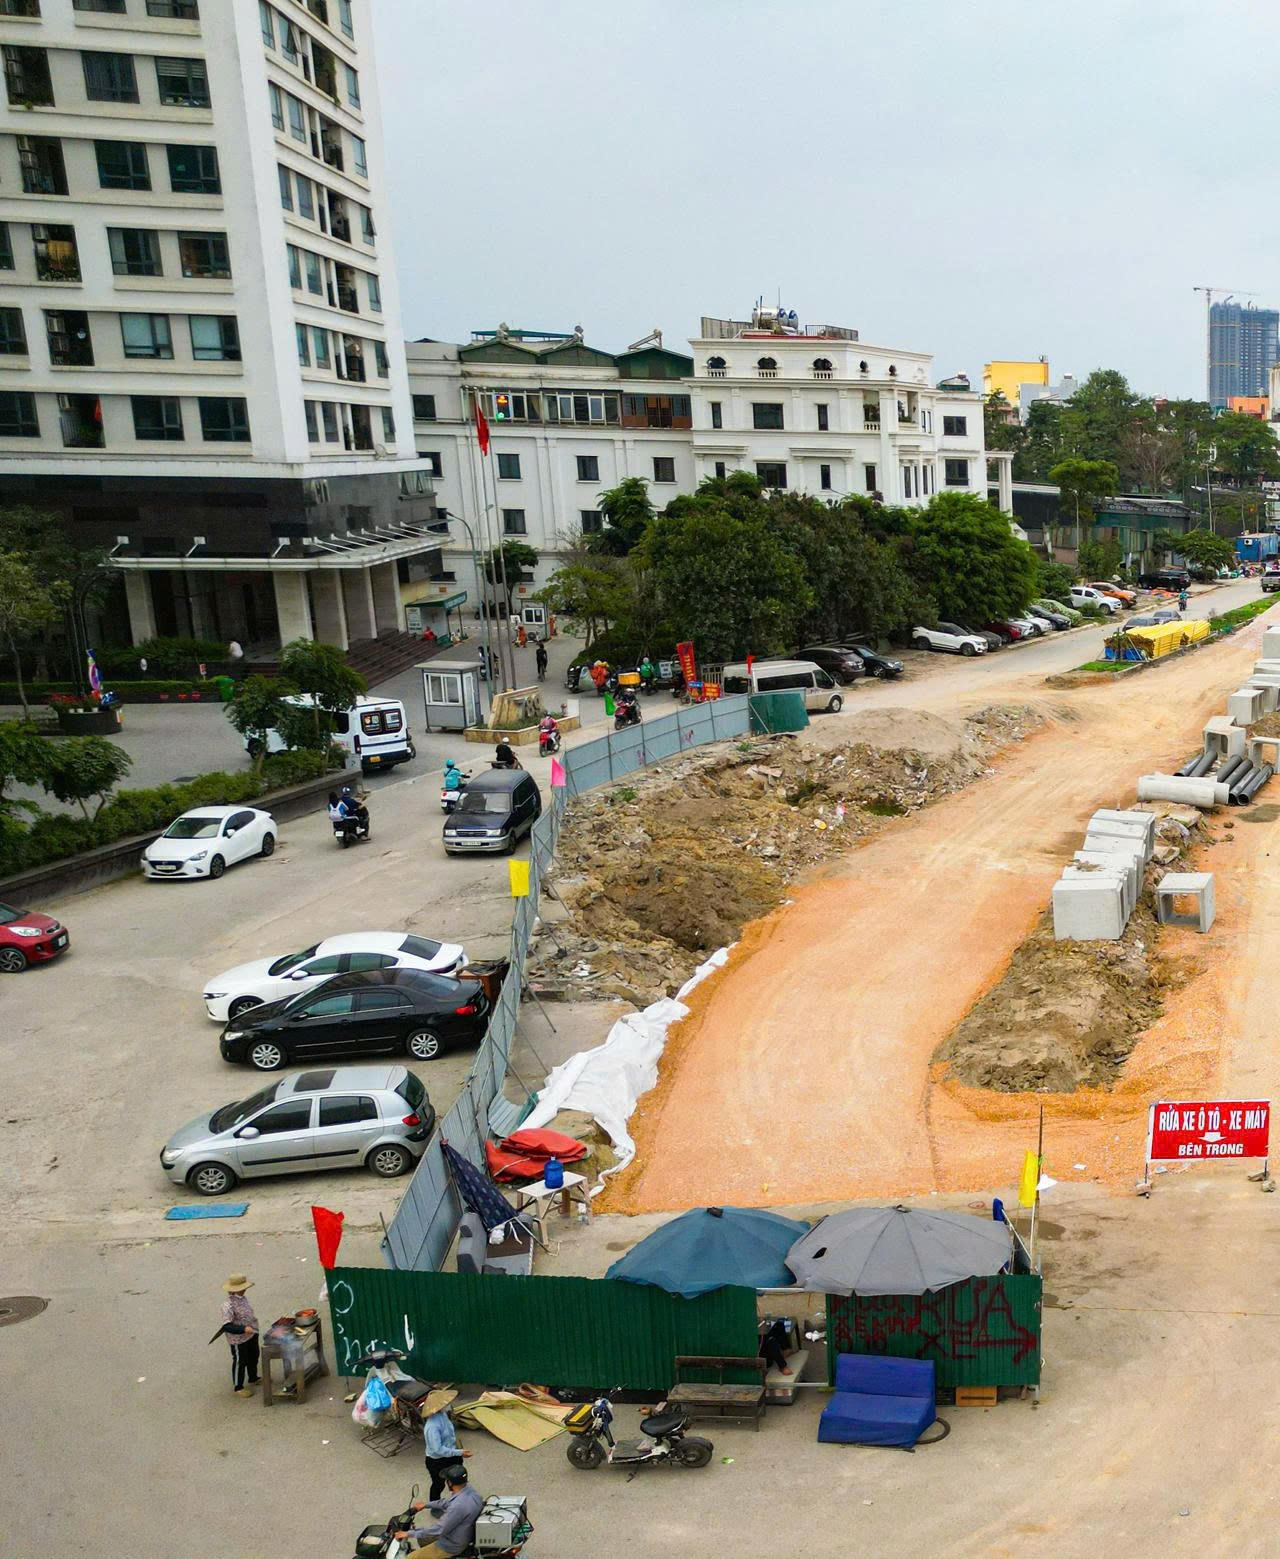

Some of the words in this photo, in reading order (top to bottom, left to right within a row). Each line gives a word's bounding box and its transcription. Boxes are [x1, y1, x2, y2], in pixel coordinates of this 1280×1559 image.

[1159, 1105, 1179, 1131] RỬA
[1182, 1111, 1195, 1130] XE
[1198, 1106, 1205, 1130] Ô
[1208, 1106, 1220, 1130] TÔ
[1229, 1110, 1242, 1130] XE
[1244, 1105, 1267, 1129] MÁY
[1178, 1142, 1202, 1155] BÊN
[1206, 1143, 1244, 1155] TRONG
